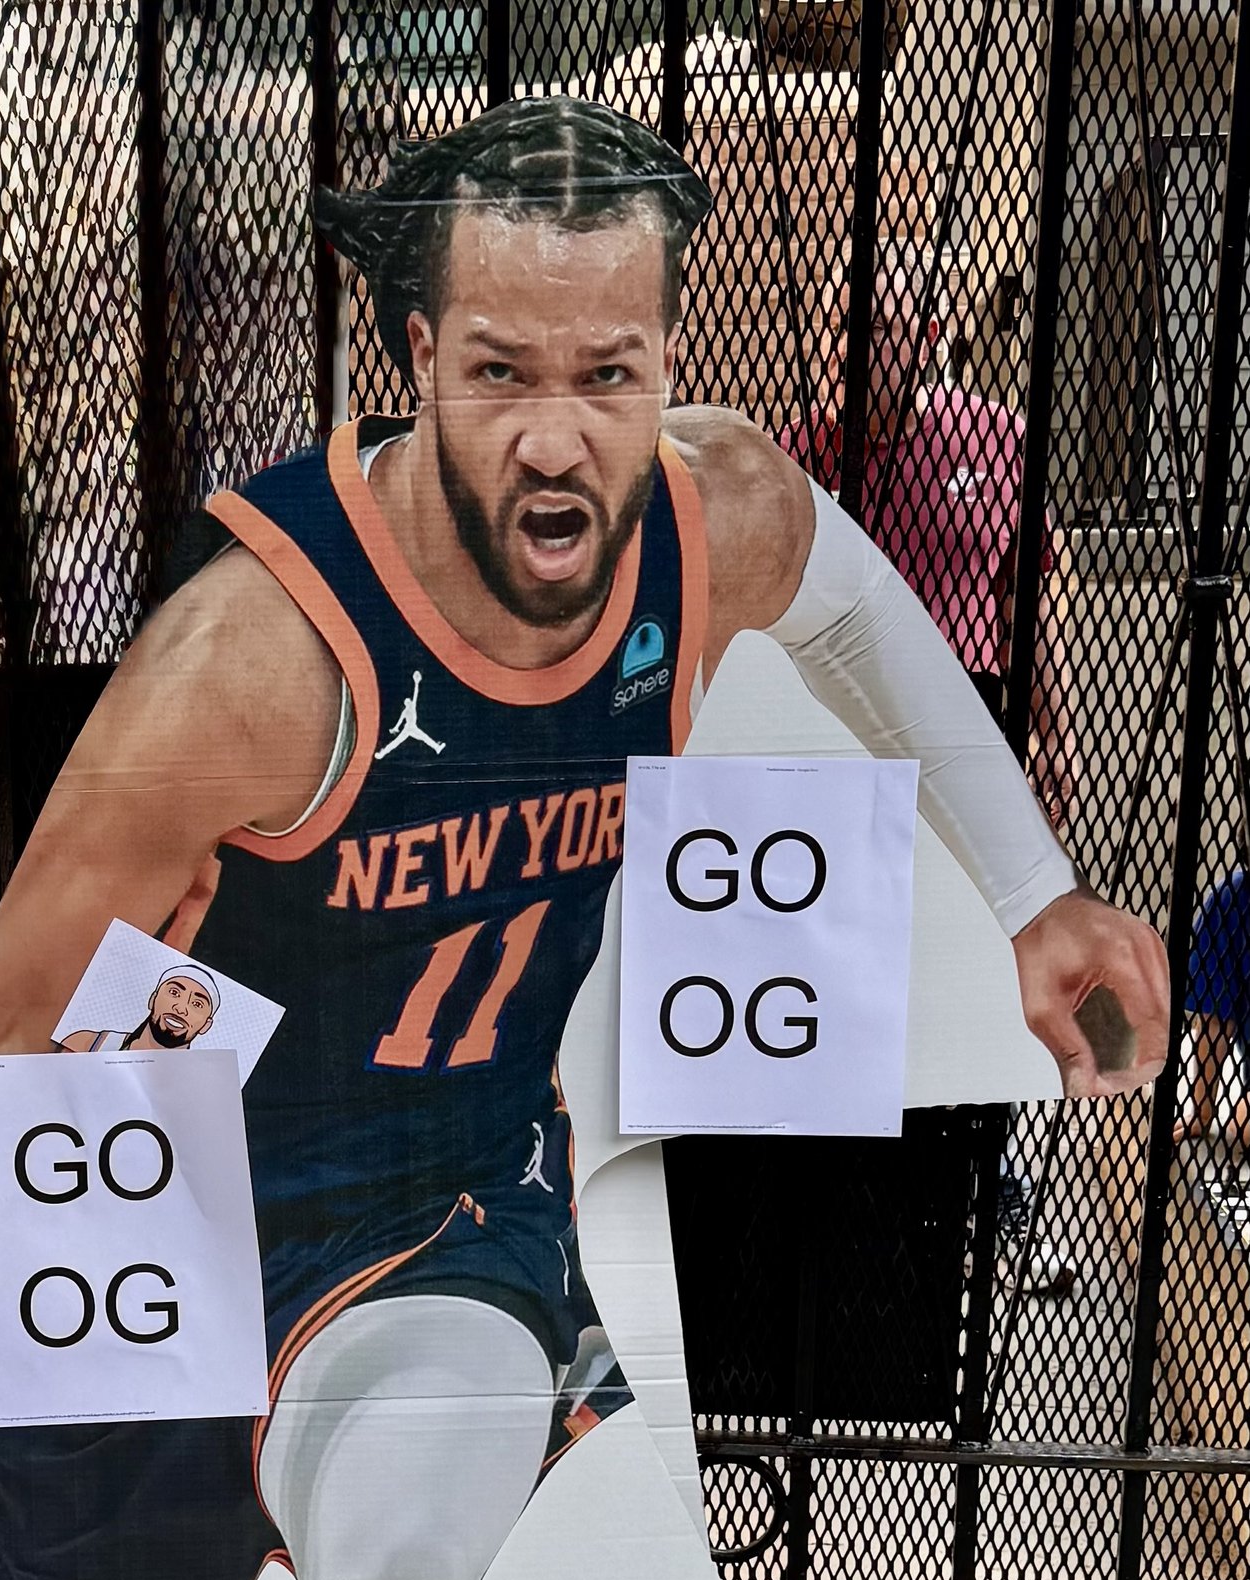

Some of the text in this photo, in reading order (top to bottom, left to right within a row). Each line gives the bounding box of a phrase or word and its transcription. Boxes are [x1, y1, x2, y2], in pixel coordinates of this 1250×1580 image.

[613, 668, 670, 708] sphere
[326, 782, 628, 912] NEW YOR
[665, 828, 827, 913] GO
[368, 900, 551, 1070] 11
[659, 975, 818, 1059] OG
[14, 1119, 174, 1205] GO
[19, 1263, 179, 1348] OG
